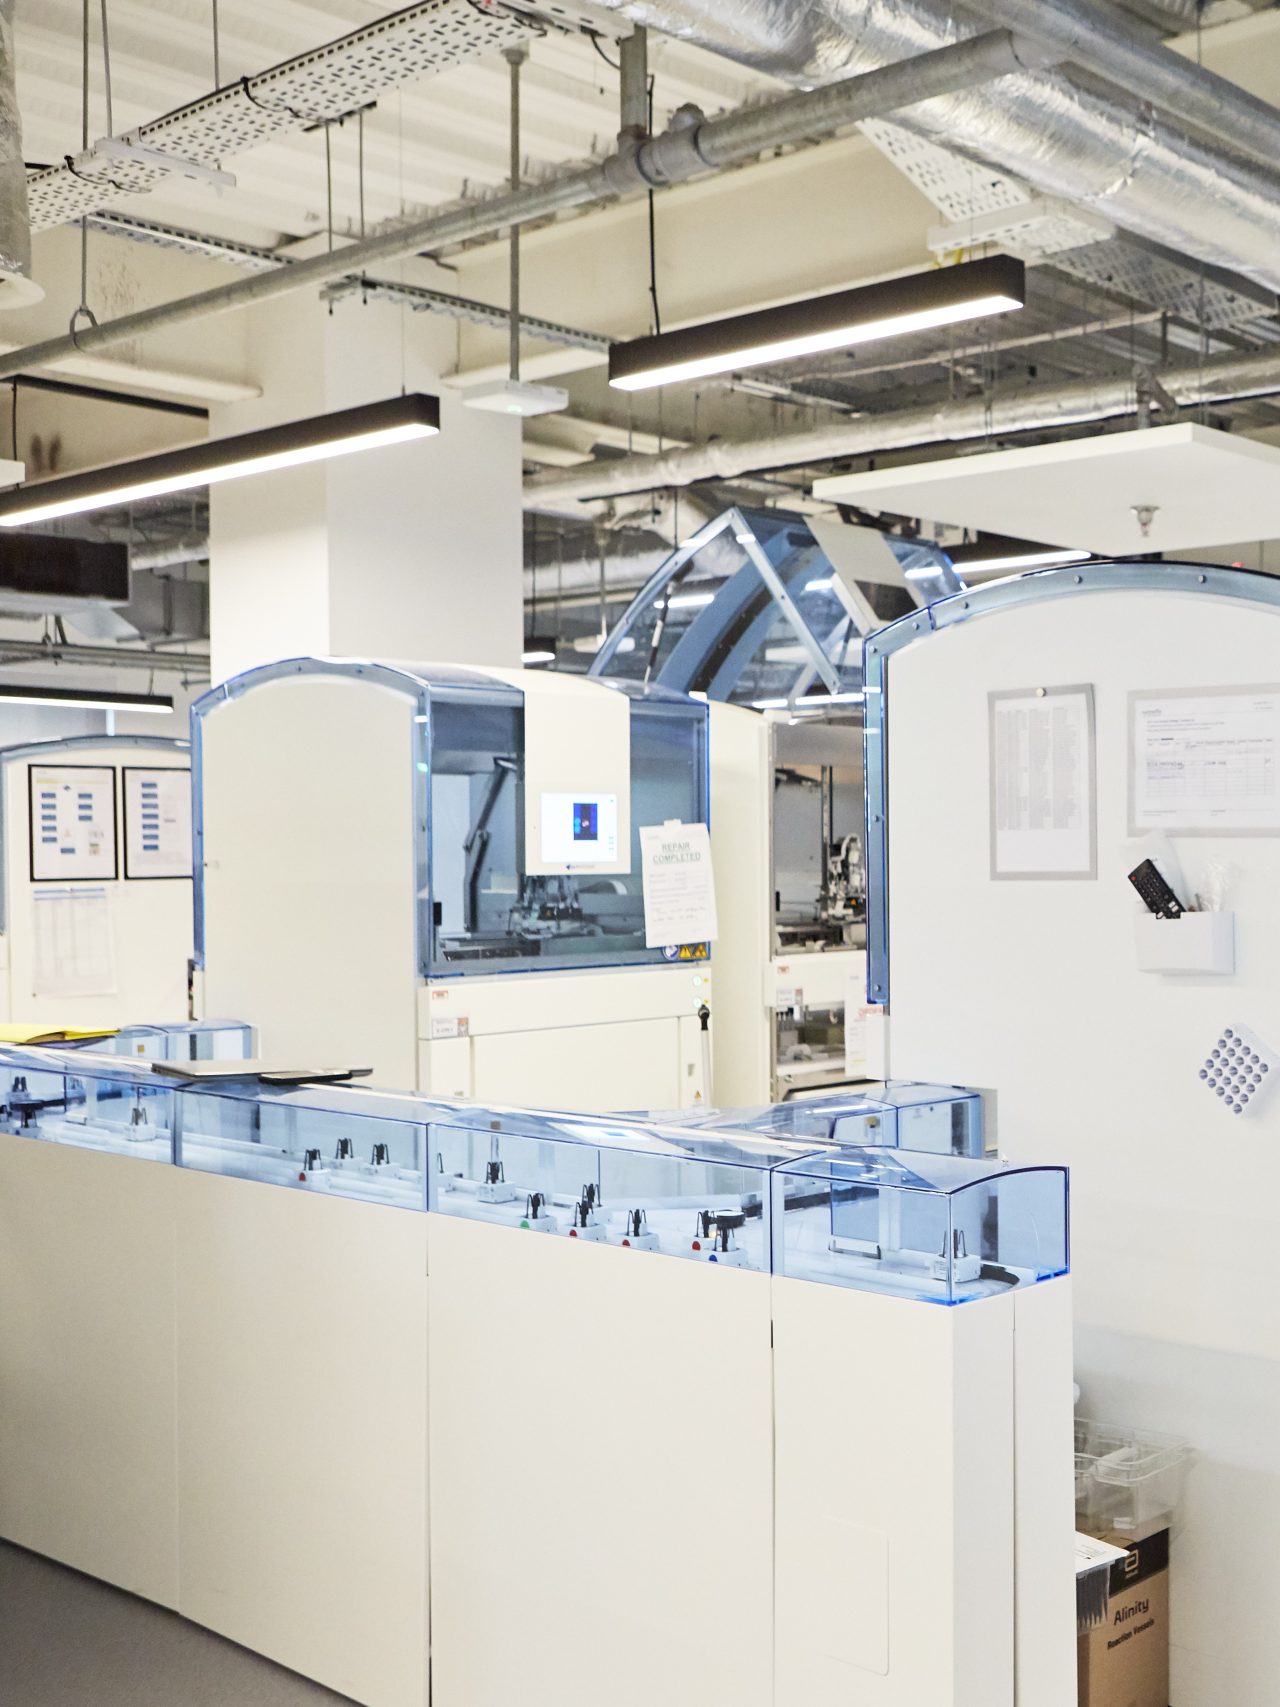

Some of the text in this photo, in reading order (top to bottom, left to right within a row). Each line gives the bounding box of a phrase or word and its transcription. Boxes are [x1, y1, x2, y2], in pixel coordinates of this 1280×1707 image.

[662, 841, 690, 852] REPAIR
[652, 852, 701, 864] COMPLETED
[1113, 1599, 1149, 1626] Alinity
[1107, 1618, 1154, 1650] Reaction Vessels
